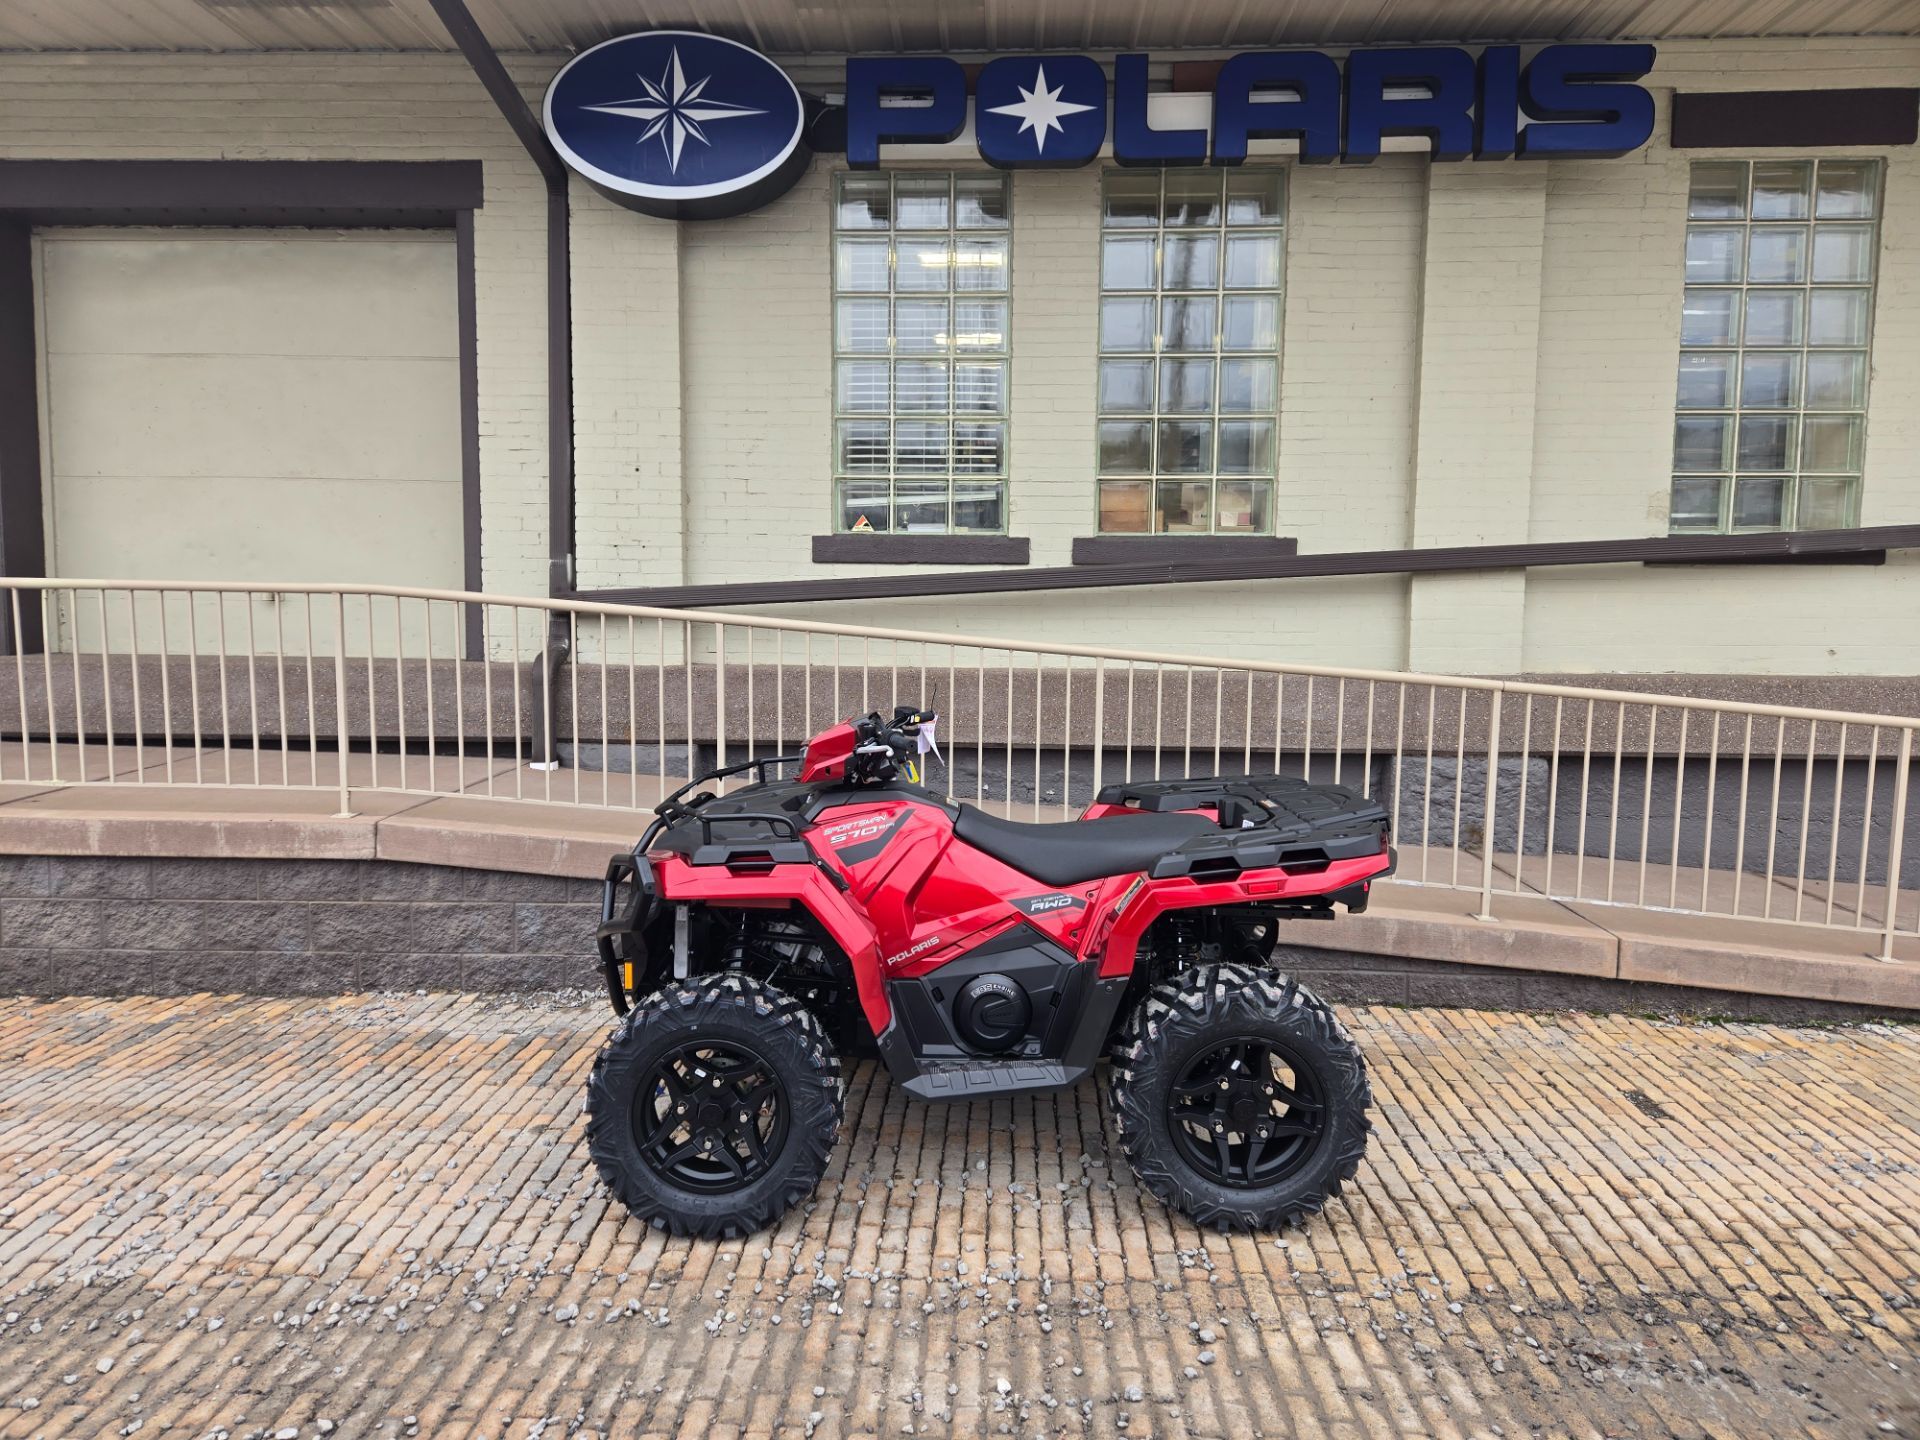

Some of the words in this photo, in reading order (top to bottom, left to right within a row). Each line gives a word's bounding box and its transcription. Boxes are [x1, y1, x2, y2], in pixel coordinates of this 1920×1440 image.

[846, 44, 1656, 169] POLARIS
[823, 814, 887, 835] SPORTSMAN
[830, 825, 878, 844] 570
[1030, 897, 1072, 911] AWD
[887, 936, 940, 966] POLARIS
